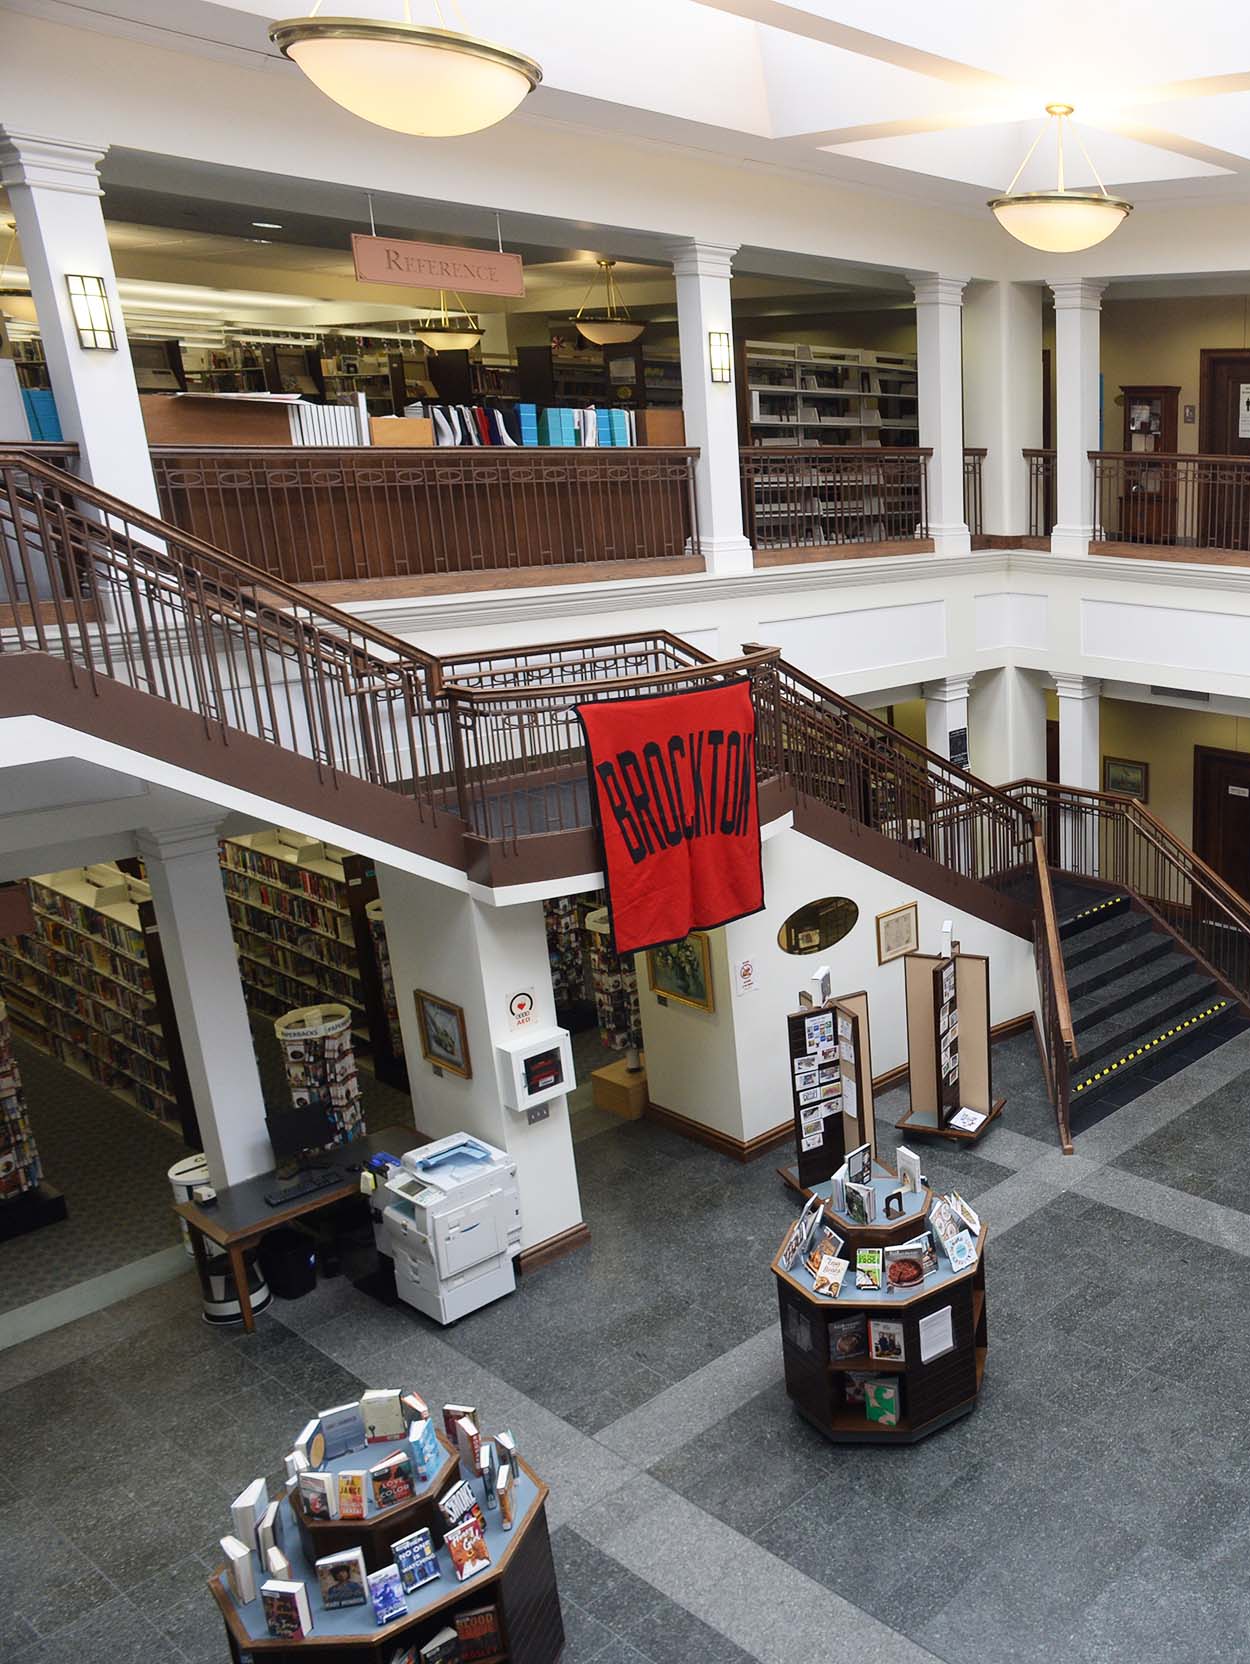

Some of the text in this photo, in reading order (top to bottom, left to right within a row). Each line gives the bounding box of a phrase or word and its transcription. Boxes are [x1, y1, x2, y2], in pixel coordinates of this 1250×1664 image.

[383, 249, 499, 283] REFERENCE
[596, 730, 752, 865] BROCKTON
[398, 1549, 412, 1560] NO
